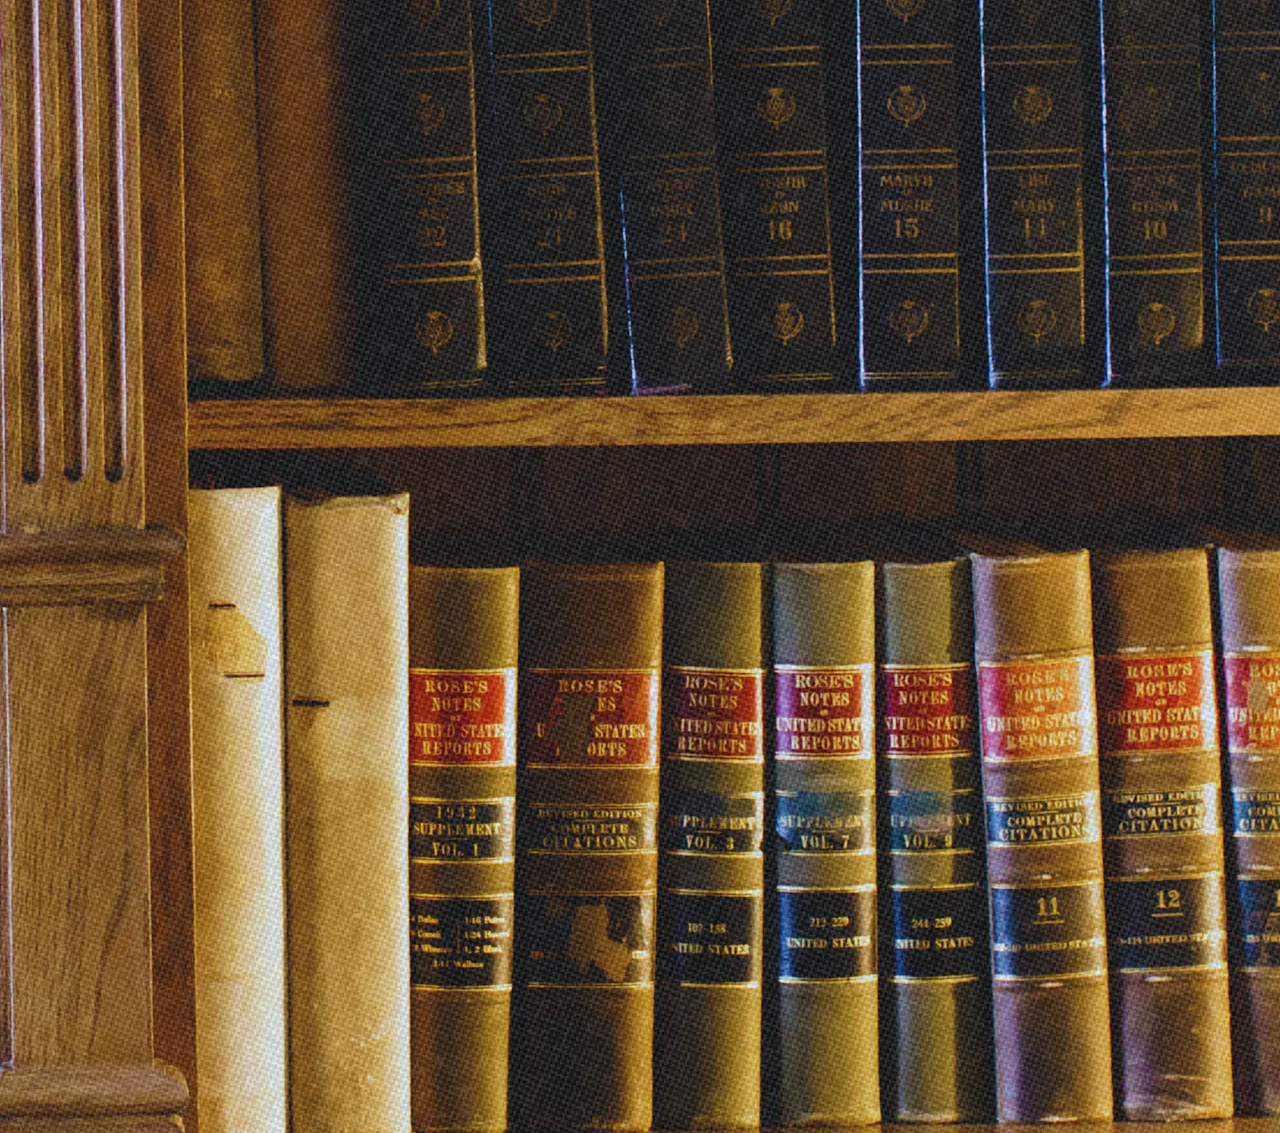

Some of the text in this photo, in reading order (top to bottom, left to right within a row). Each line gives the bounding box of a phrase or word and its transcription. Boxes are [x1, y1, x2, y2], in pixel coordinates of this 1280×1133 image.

[768, 219, 792, 241] 16
[894, 218, 920, 239] 15
[1144, 219, 1167, 239] 10
[1006, 668, 1069, 685] ROSE'S
[1127, 662, 1193, 679] ROSE'S
[425, 680, 488, 693] ROSE'S
[558, 679, 622, 693] ROSE'S
[685, 675, 743, 691] ROSE'S
[795, 675, 854, 689] ROSE'S
[894, 673, 952, 688] ROSE'S
[1014, 686, 1065, 704] NOTES
[1135, 681, 1187, 697] NOTES
[431, 697, 481, 711] NOTES
[689, 693, 738, 709] NOTES
[800, 692, 850, 706] NOTES
[898, 691, 948, 705] NOTES
[1045, 711, 1079, 729] STAT
[1107, 706, 1202, 725] UNITED STAT
[414, 723, 504, 738] NITED STATE
[595, 724, 645, 738] STATES
[672, 718, 758, 736] NITED STATE
[776, 717, 863, 732] UNITED STAT
[885, 716, 924, 731] NITED
[890, 734, 960, 748] REPORTS
[1006, 731, 1077, 750] REPORTS
[1127, 725, 1199, 743] REPORTS
[422, 741, 492, 755] REPORTS
[677, 736, 747, 753] REPORTS
[791, 735, 861, 750] REPORTS
[594, 809, 644, 819] EDITION
[1007, 812, 1082, 827] COMPLETE
[413, 822, 502, 836] SUPPLEMENT
[1119, 817, 1203, 832] CITATION
[999, 825, 1090, 841] CITATIONS
[685, 835, 718, 850] VOL.
[800, 835, 850, 850] VOL. 7
[903, 834, 953, 848] VOL. 9
[432, 842, 464, 856] VOL.
[1037, 897, 1060, 915] 11
[1156, 890, 1181, 908] 12
[708, 944, 750, 955] STATES
[787, 935, 872, 949] UNITED STATES
[896, 937, 974, 949] NITED STATES
